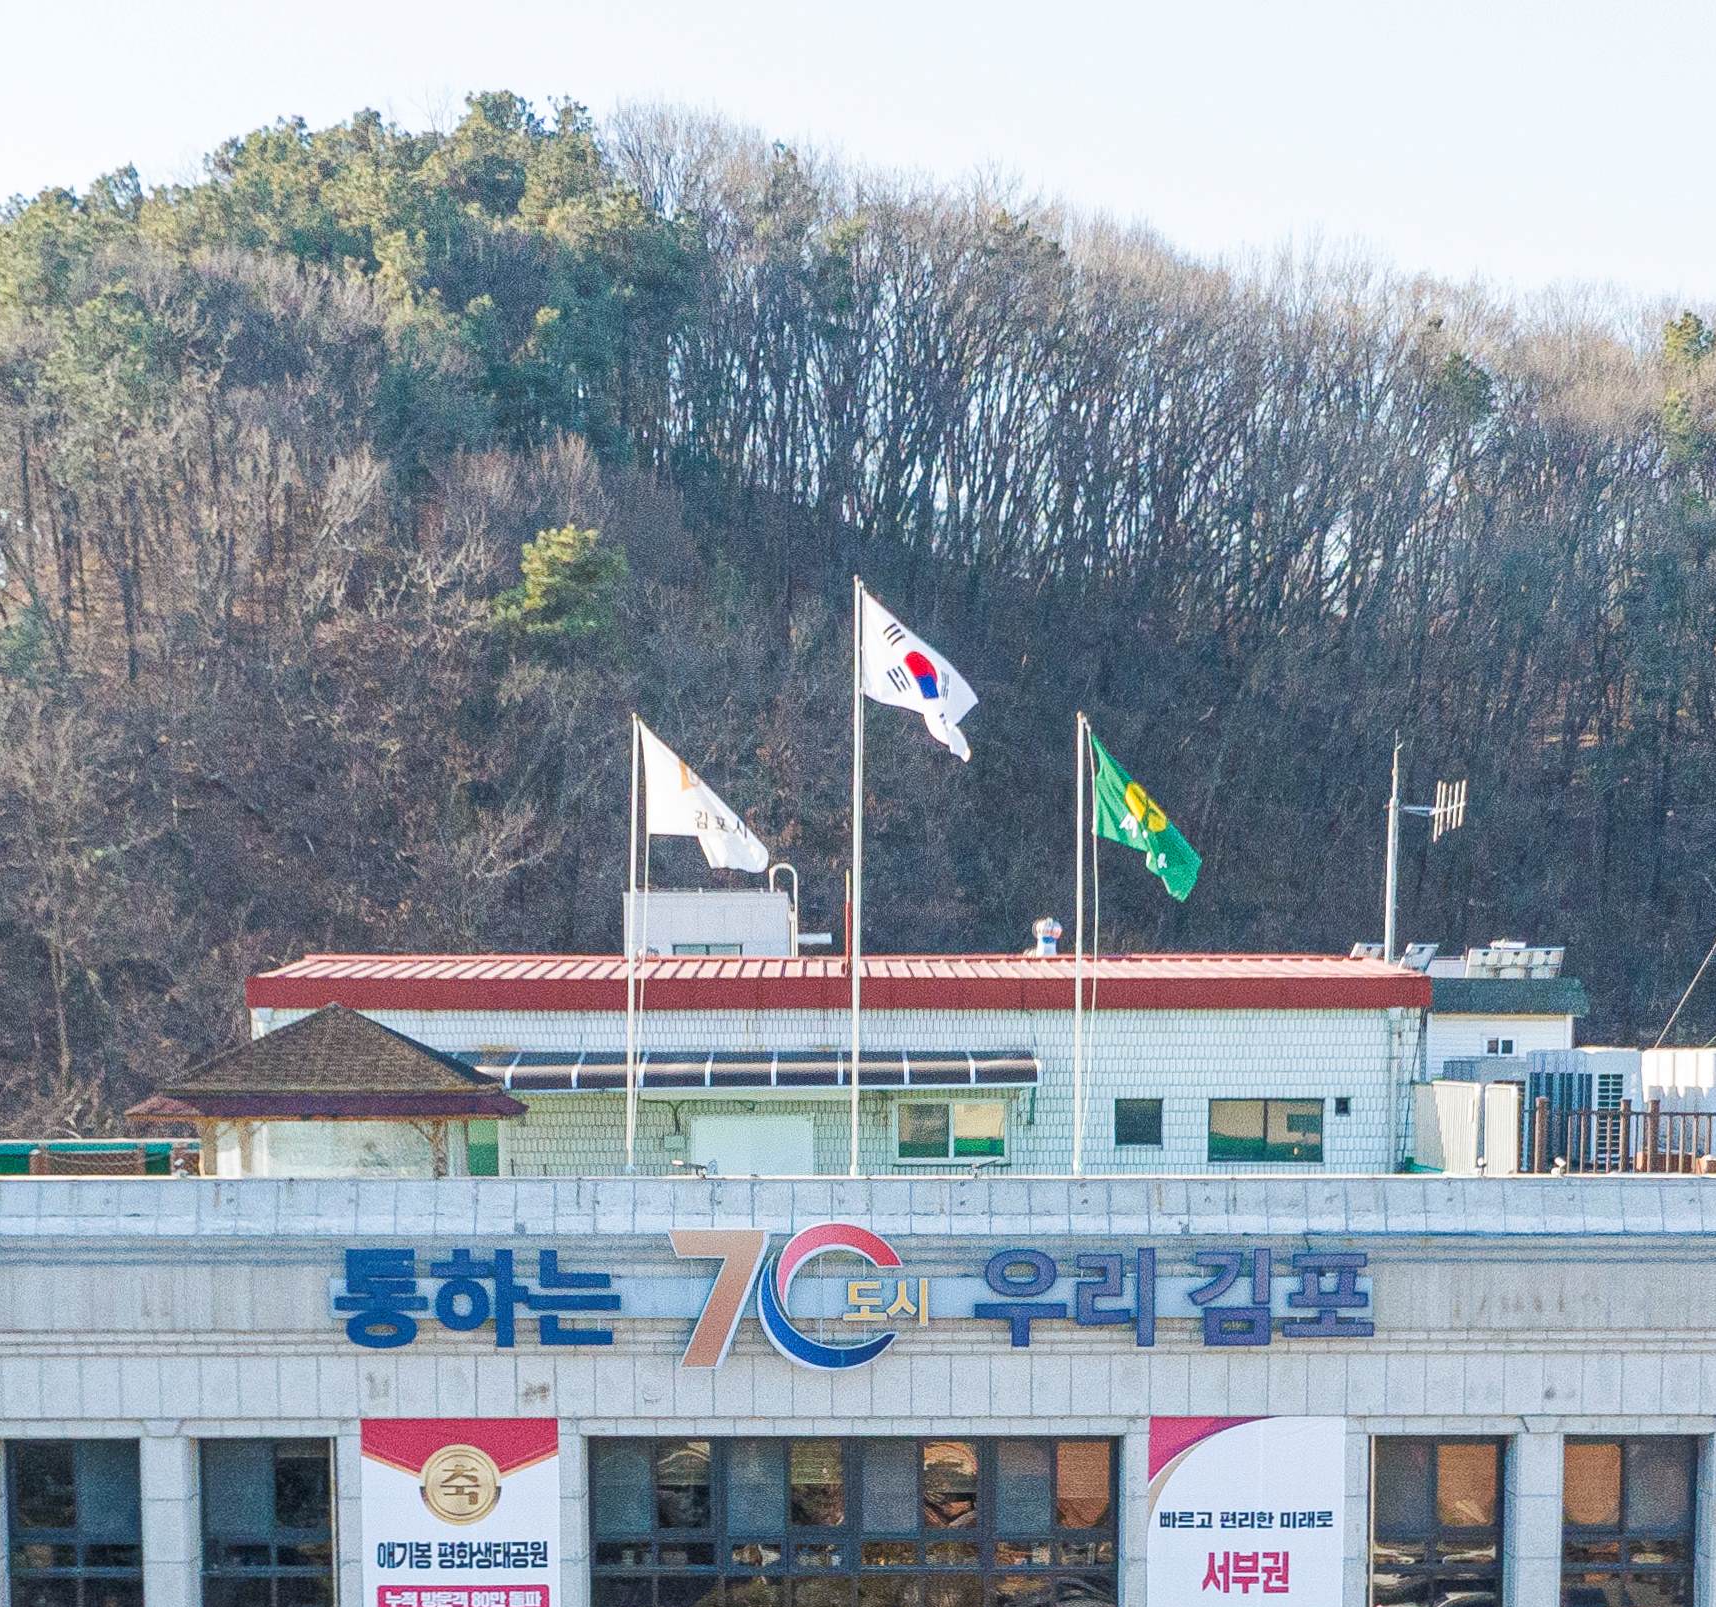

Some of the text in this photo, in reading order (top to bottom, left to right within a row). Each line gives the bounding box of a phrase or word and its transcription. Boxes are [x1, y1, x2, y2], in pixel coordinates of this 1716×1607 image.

[694, 810, 747, 839] 김포시
[333, 1247, 621, 1350] 통하는
[841, 1278, 930, 1328] 도시
[973, 1248, 1156, 1349] 우리
[1189, 1248, 1376, 1348] 김포
[1159, 1511, 1334, 1529] 빠르고 편리한 미래로
[377, 1541, 548, 1569] 애기봉 평화생태공원
[1202, 1551, 1290, 1594] 서부권
[384, 1591, 418, 1607] 누적
[421, 1592, 470, 1607] 방문객
[508, 1592, 543, 1607] 돌파
